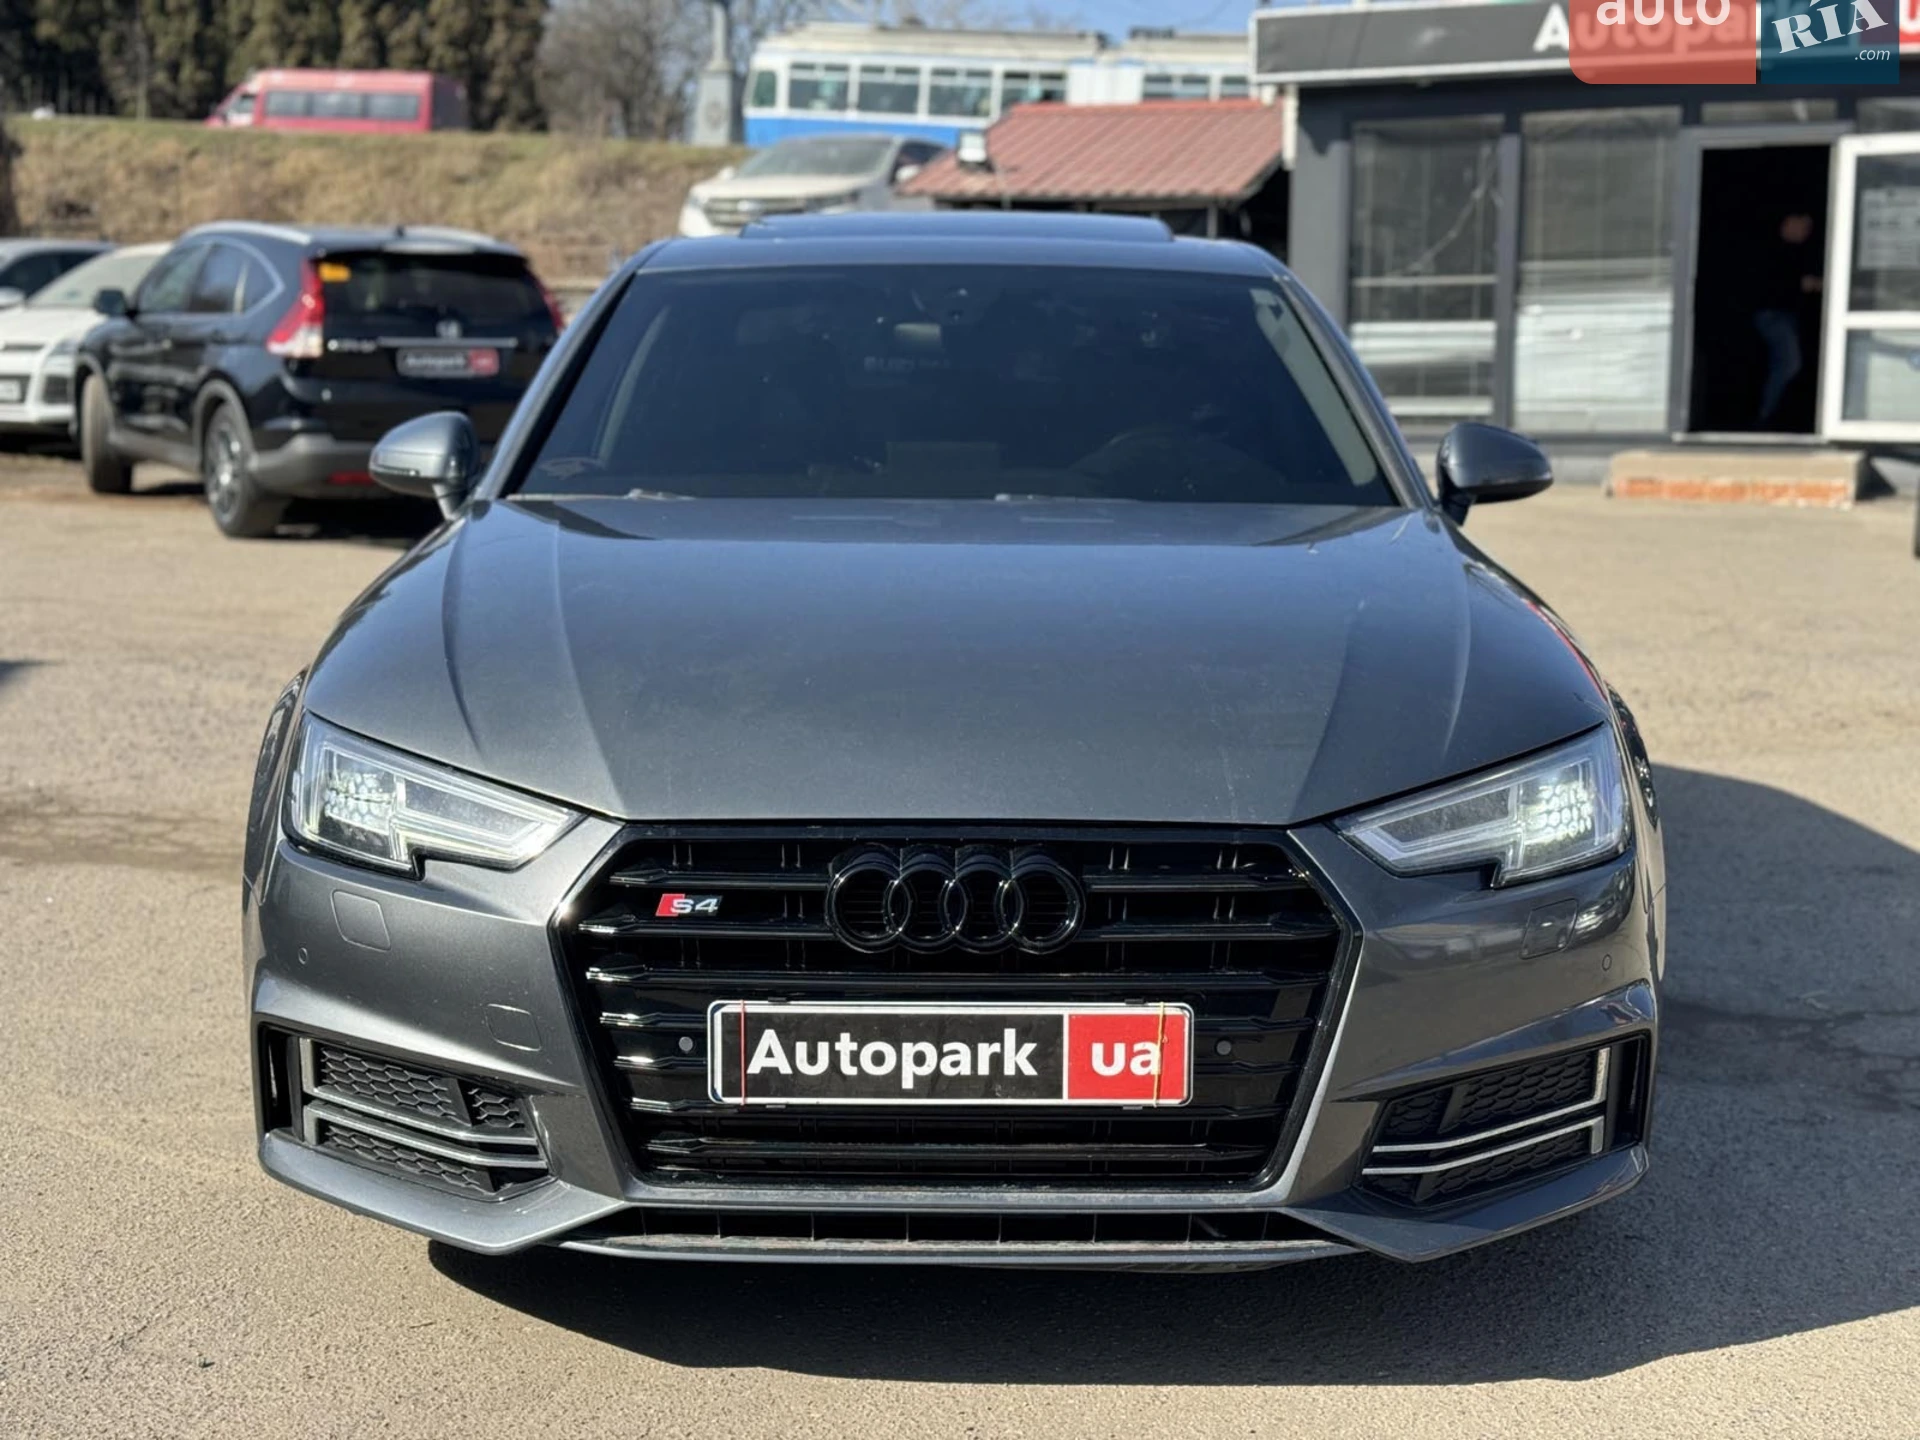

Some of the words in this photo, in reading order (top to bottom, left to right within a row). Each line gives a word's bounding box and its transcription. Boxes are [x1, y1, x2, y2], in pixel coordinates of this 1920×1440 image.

[670, 898, 719, 914] S4
[746, 1027, 1038, 1090] Autopark
[1091, 1041, 1161, 1076] ua
